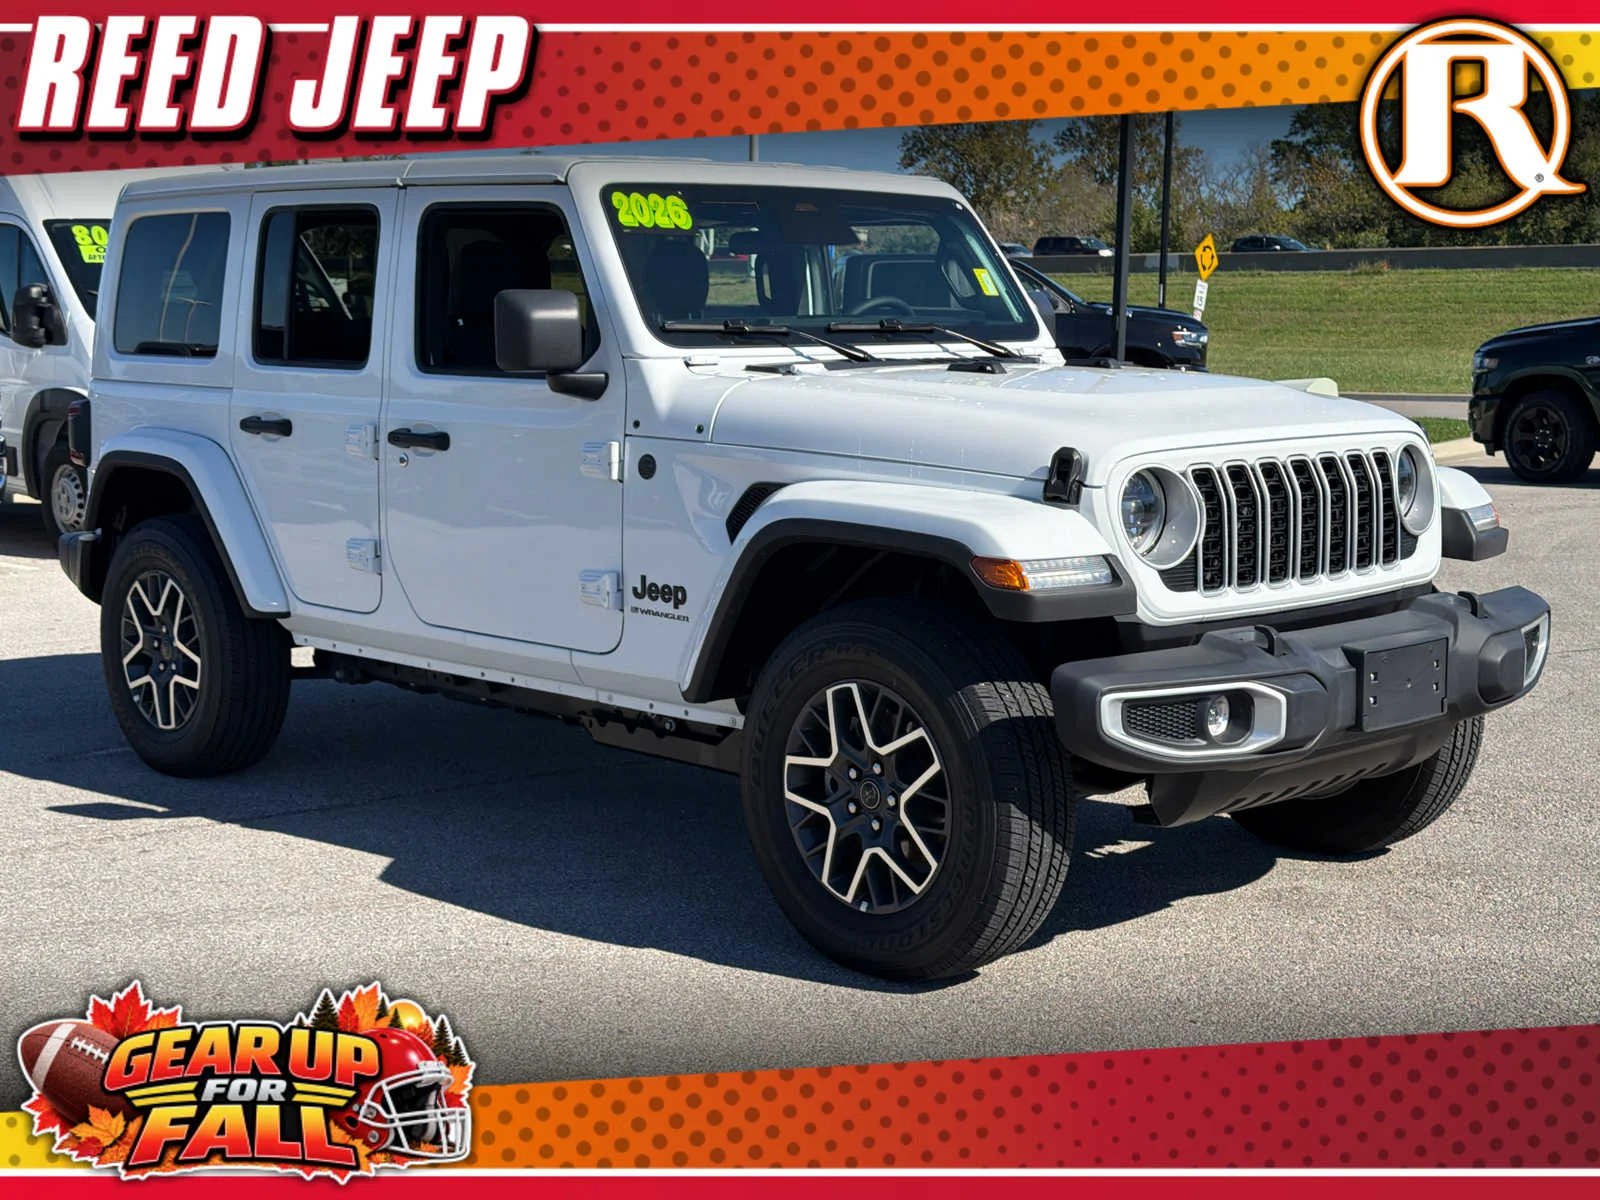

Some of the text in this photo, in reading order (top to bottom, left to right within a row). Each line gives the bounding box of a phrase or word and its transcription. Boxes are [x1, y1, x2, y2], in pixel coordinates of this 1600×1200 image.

[611, 191, 693, 230] 2026
[632, 574, 687, 610] Jeep
[640, 607, 690, 623] WRANGLER
